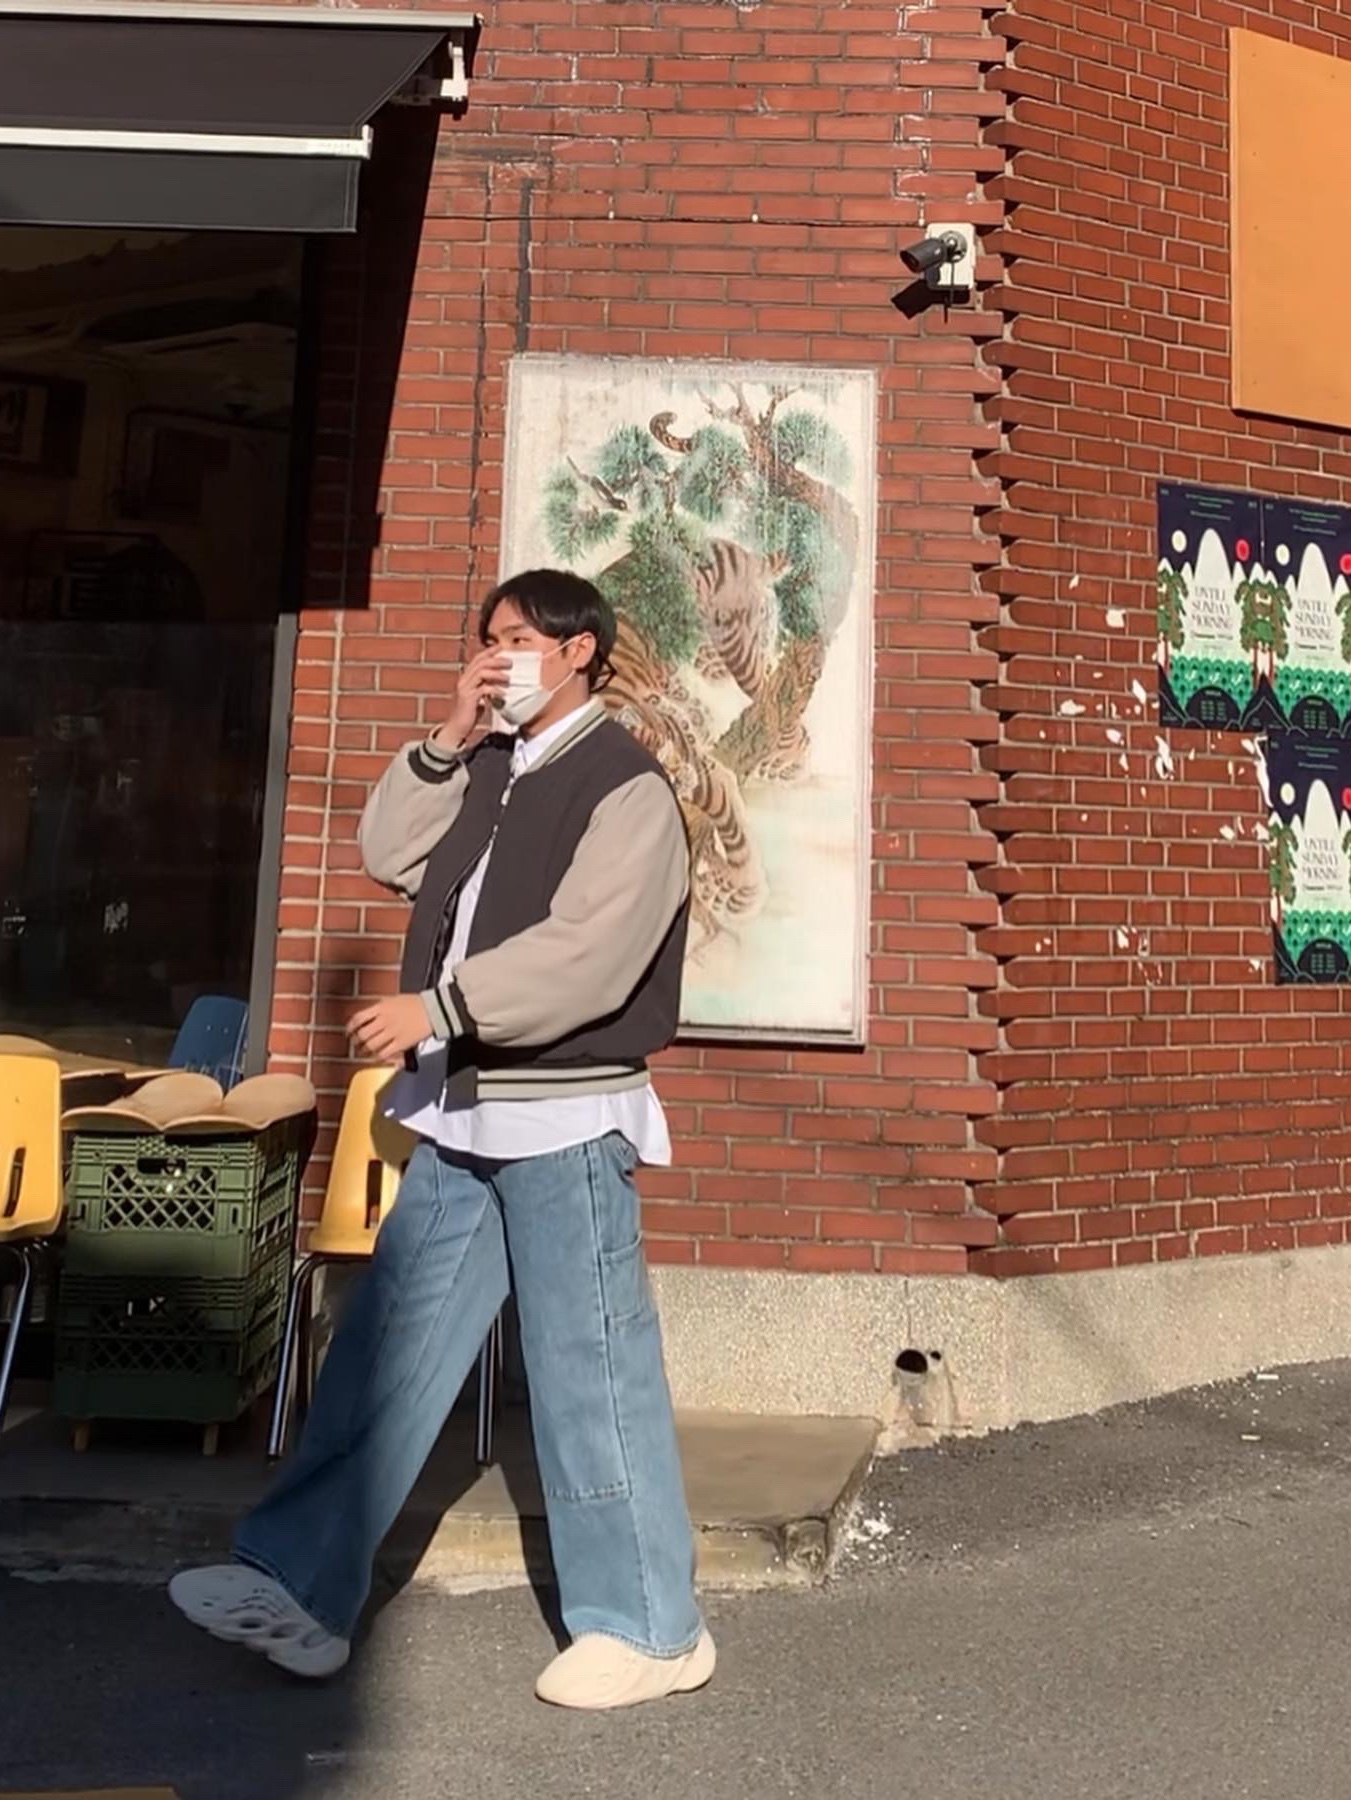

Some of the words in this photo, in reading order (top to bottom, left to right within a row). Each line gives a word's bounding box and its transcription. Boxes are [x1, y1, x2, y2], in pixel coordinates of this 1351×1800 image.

[1191, 599, 1231, 616] SUNDAY
[1294, 611, 1333, 627] SUNDAY
[1301, 852, 1340, 867] SUNDAY
